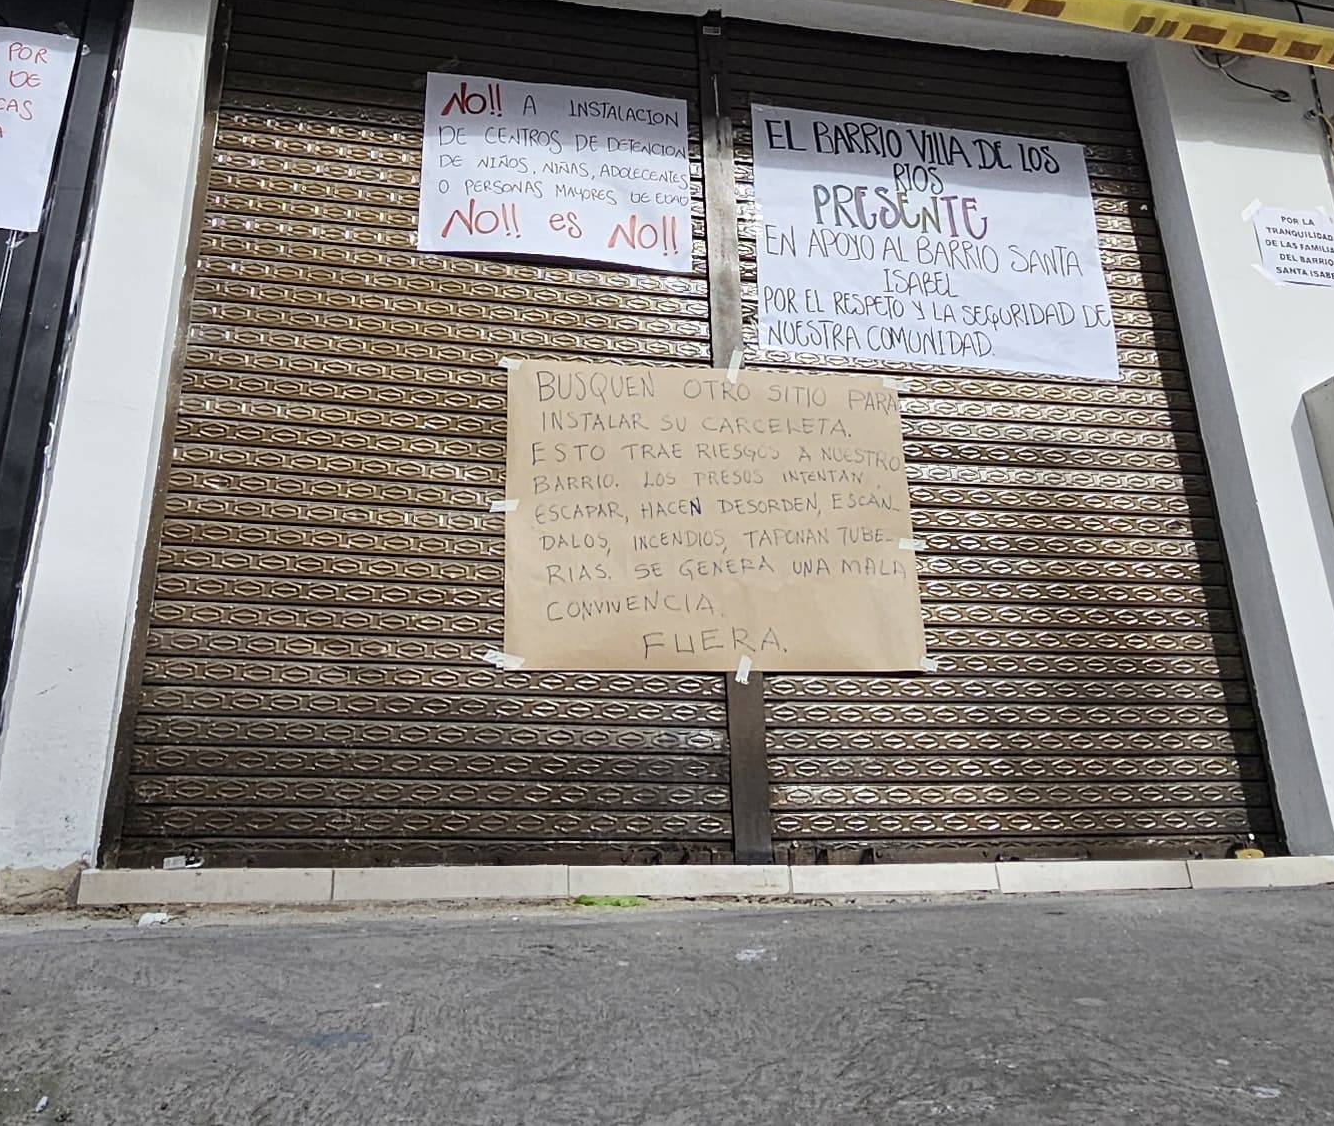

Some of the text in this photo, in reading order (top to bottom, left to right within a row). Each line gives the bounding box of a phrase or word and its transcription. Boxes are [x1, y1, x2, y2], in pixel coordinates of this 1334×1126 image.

[9, 41, 49, 64] POR
[9, 71, 41, 88] DE
[522, 95, 537, 116] A
[568, 99, 679, 128] INSTALACION
[438, 125, 687, 160] DE CENTROS DE DETENCION
[764, 119, 807, 153] EL
[813, 120, 903, 158] BARRIO
[972, 138, 1012, 171] DE
[1018, 143, 1061, 174] LOS
[439, 154, 463, 169] DE
[892, 162, 945, 194] RIOS
[438, 179, 449, 194] O
[465, 179, 543, 199] PERSONAS
[555, 185, 617, 206] MAYORES
[812, 184, 989, 241] PRESENTE
[1281, 216, 1315, 226] POR LA
[549, 212, 583, 239] es
[1265, 226, 1334, 242] TRANQUILIDAD
[764, 224, 1084, 277] EN APOYO AL BARRIO SANTA
[1265, 239, 1278, 247] DE
[1280, 240, 1298, 250] LAS
[1275, 266, 1307, 276] SANTA
[1279, 254, 1334, 266] DEL BARRIO
[883, 268, 959, 298] ISABEL
[763, 285, 799, 315] POR
[804, 289, 826, 314] EL
[833, 290, 905, 320] RESPETO
[932, 301, 957, 324] LA
[961, 301, 1076, 331] SEGURIDAD
[1084, 304, 1111, 329] DE
[767, 319, 861, 352] NUESTRA
[536, 370, 898, 421] BUSQUEN OTRO SITIO PARA
[541, 411, 649, 433] INSTALAR
[659, 414, 687, 433] SU
[530, 441, 606, 467] ESTO
[620, 442, 684, 461] TRAE
[798, 445, 812, 463] A
[820, 446, 902, 473] NUESTRO
[643, 471, 676, 489] LOS
[695, 471, 764, 487] PRESOS
[640, 497, 703, 518] HACEN
[742, 528, 830, 550] TAPONAN
[634, 563, 663, 580] SE
[678, 558, 775, 580] GENERA
[792, 559, 831, 579] UNA
[840, 560, 907, 580] MALA
